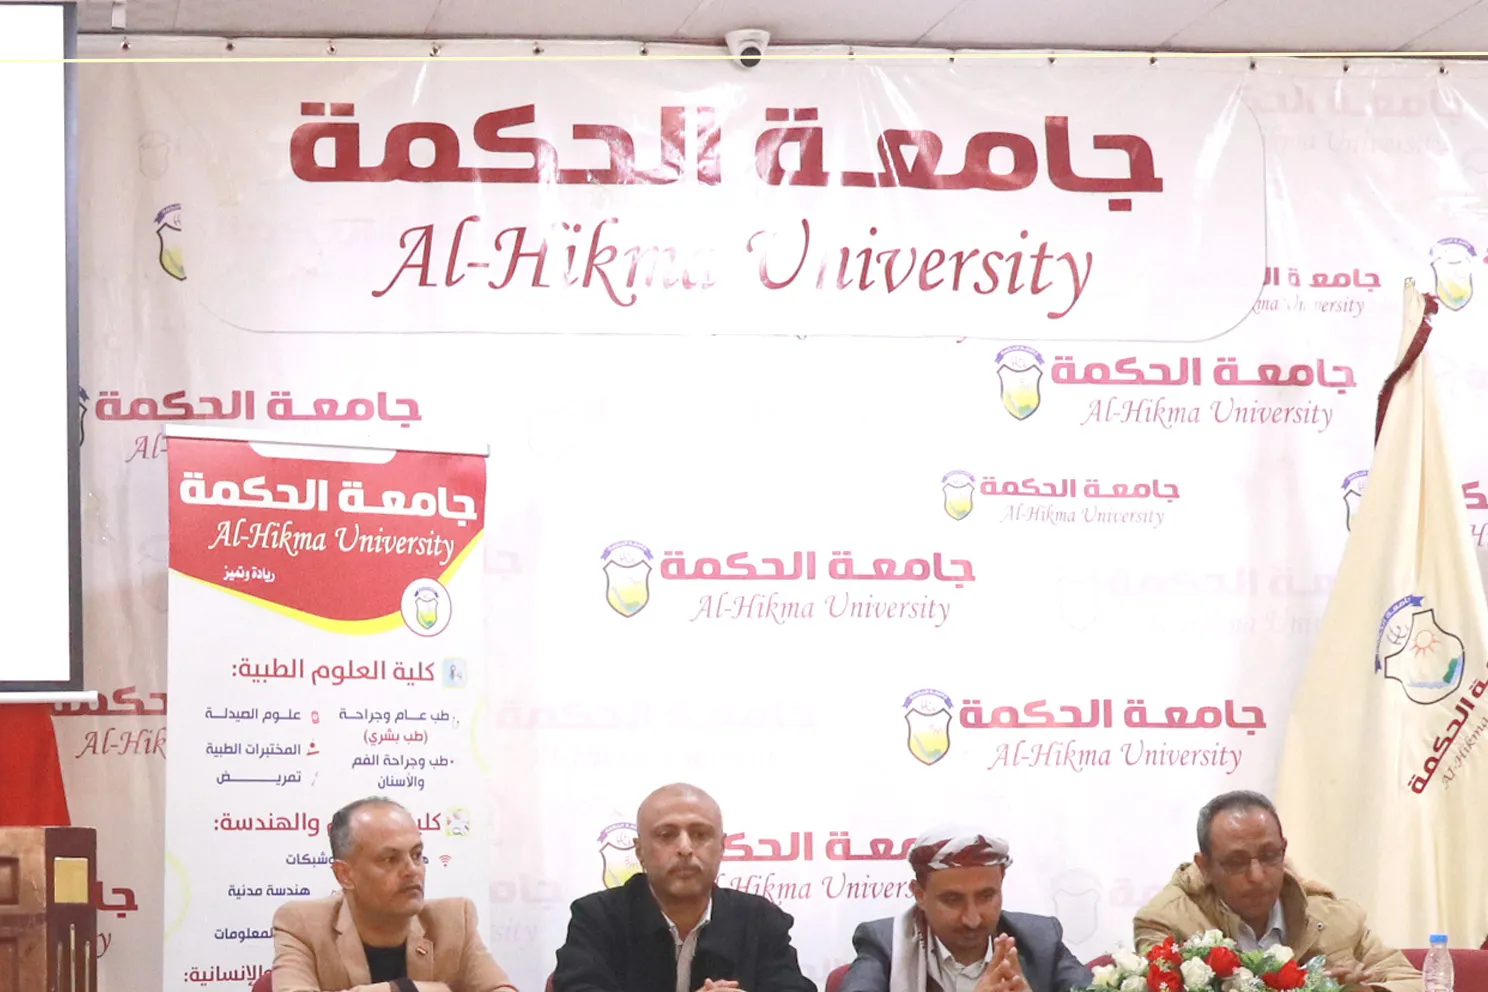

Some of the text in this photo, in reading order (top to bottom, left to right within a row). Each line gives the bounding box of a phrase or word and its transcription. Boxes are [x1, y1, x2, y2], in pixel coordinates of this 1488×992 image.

[289, 102, 721, 186] الحكمة
[754, 107, 1164, 211] جامعة
[1050, 355, 1357, 394] جامعة الحكمة
[94, 390, 254, 421] الحكمة
[267, 391, 422, 429] جامعة
[1082, 395, 1334, 433] Al-Hikma University
[179, 471, 477, 526] جامعة الحكمة
[979, 476, 1180, 502] جامعة الحكمة
[1000, 504, 1165, 528] Al-Hikma University
[208, 519, 455, 565] Al-Hikma University
[659, 551, 976, 589] جامعة الحكمة
[690, 593, 951, 628] Al-Hikma University
[232, 658, 435, 686] كلية العلوم الطبية:
[431, 709, 450, 722] طب
[959, 699, 1267, 735] جامعة الحكمة
[75, 727, 167, 760] Al-Hik
[205, 743, 301, 758] المختبرات الطبية
[987, 741, 1243, 774] Al-Hikma University
[1408, 696, 1475, 794] الحكمة
[351, 754, 449, 770] طب وجراحة الفم
[214, 812, 321, 837] والهندسة:
[418, 812, 441, 835] كلي
[228, 884, 311, 900] هندسة مدنية
[214, 927, 273, 943] لمعلومات
